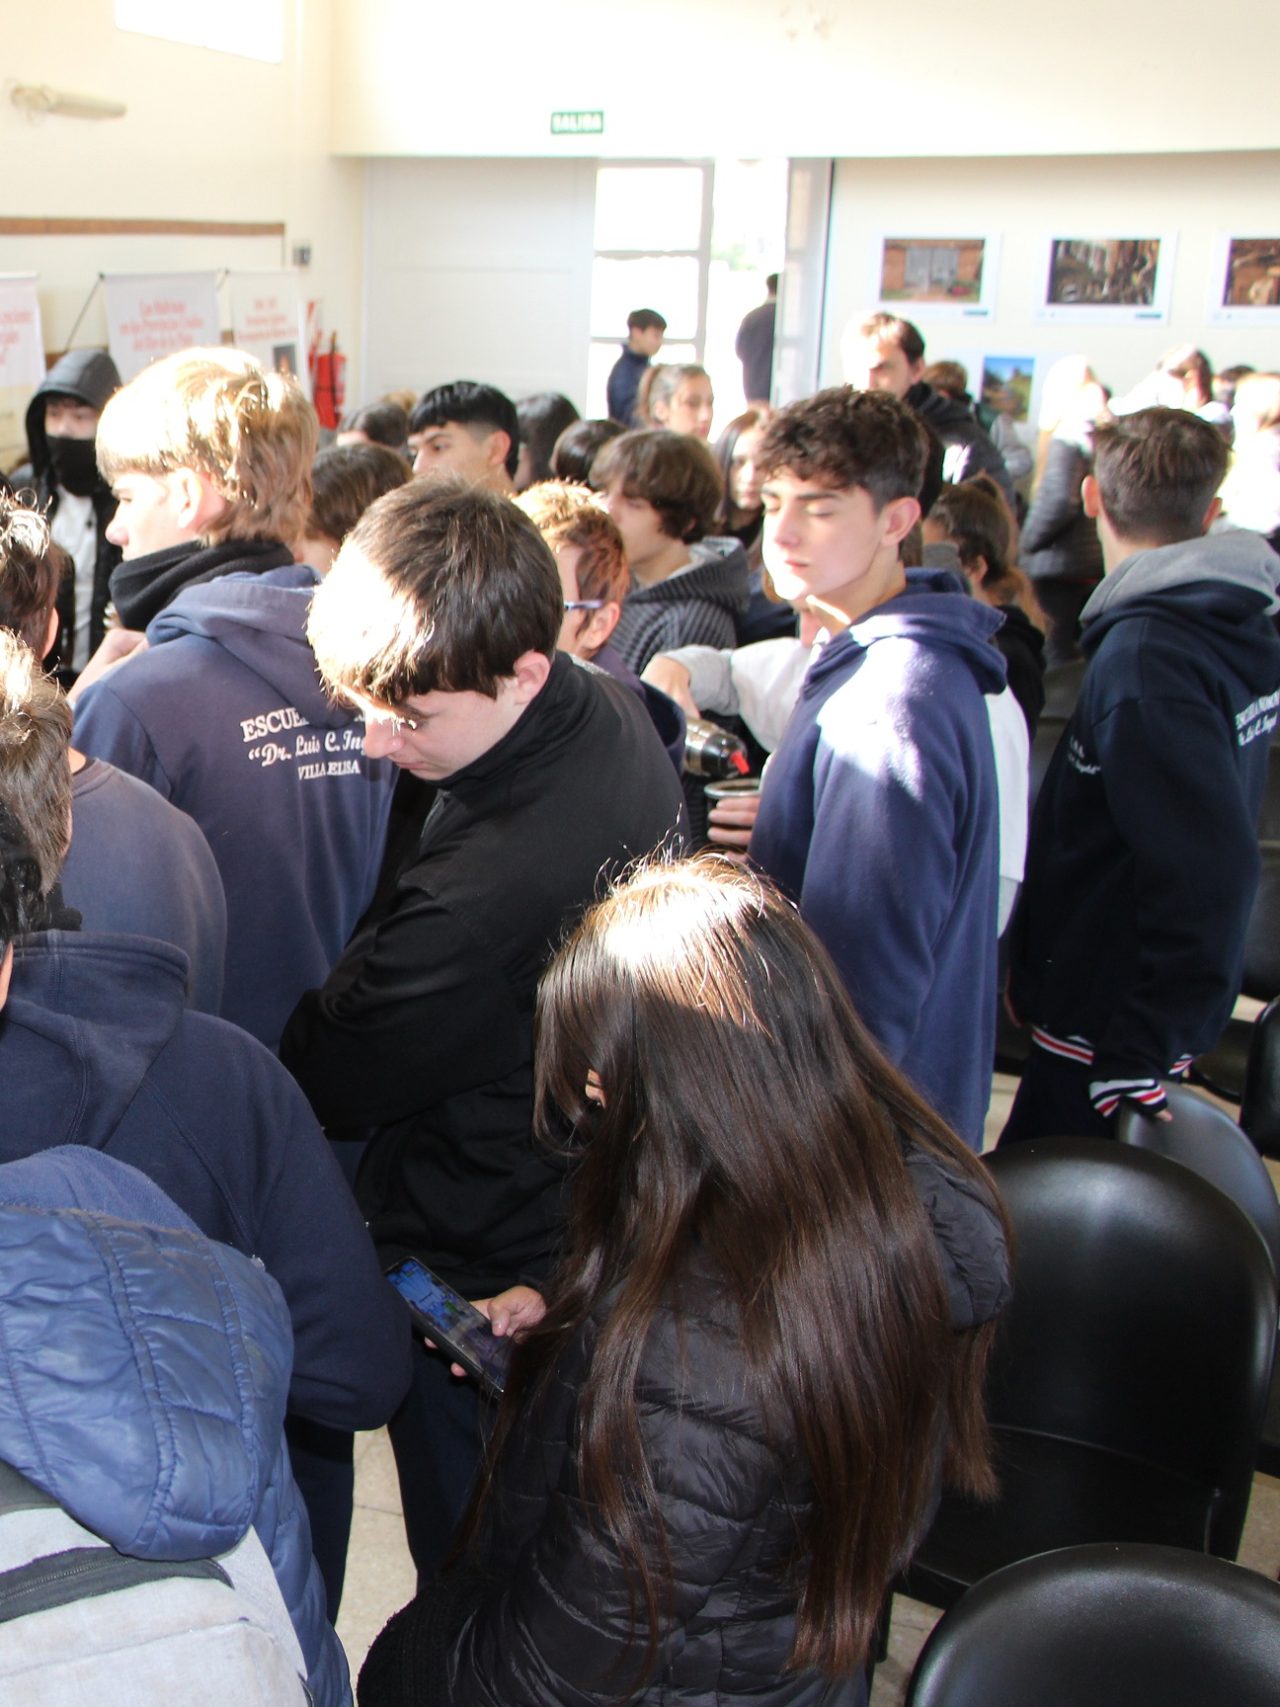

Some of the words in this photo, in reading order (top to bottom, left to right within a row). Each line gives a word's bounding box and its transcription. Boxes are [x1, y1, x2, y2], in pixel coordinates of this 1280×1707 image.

[295, 734, 320, 758] Luis
[324, 731, 341, 753] C.
[297, 762, 326, 780] VILLA
[327, 759, 361, 776] ELISA
